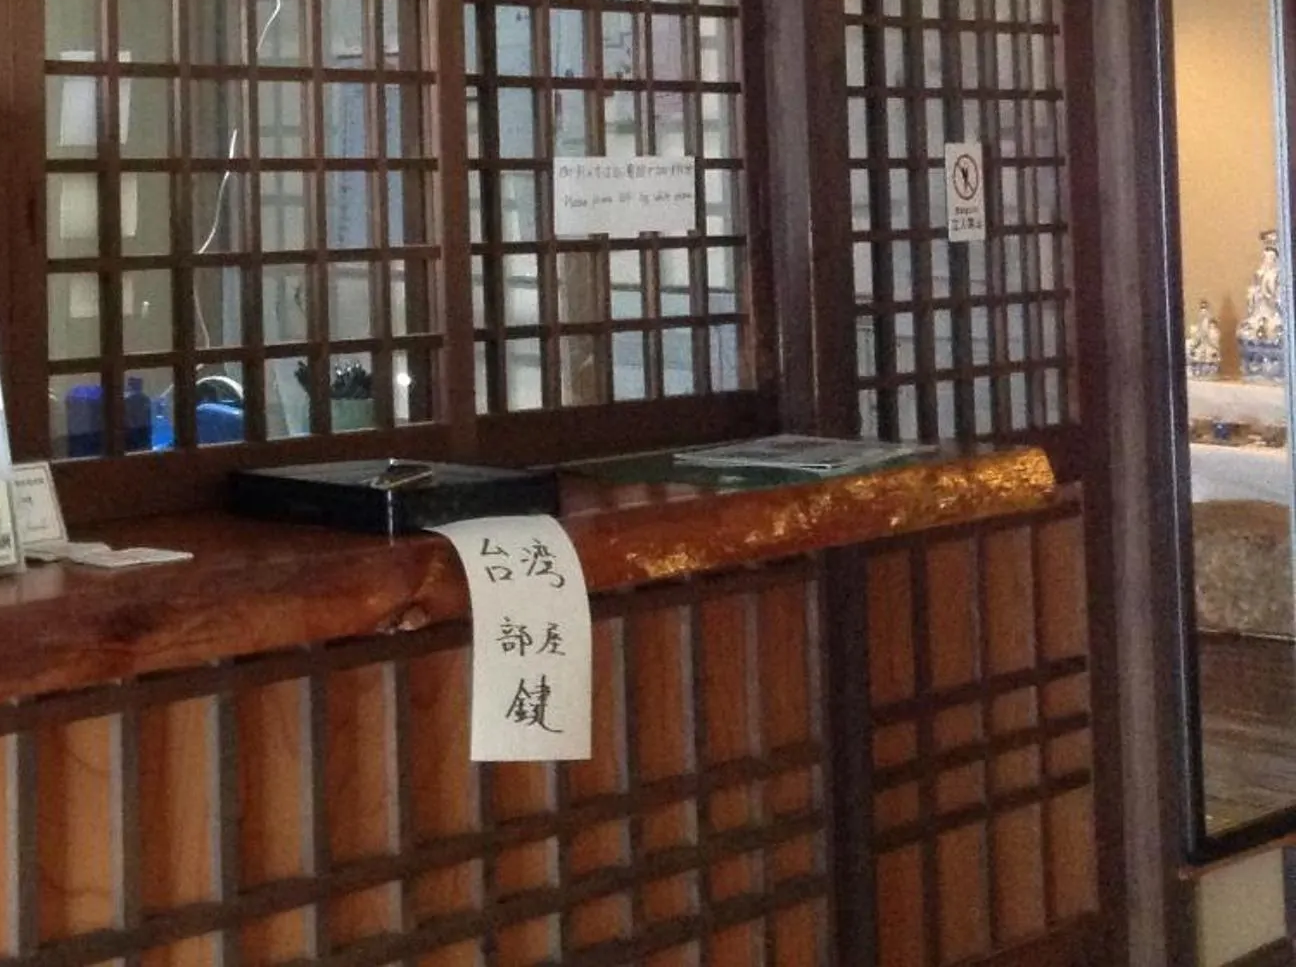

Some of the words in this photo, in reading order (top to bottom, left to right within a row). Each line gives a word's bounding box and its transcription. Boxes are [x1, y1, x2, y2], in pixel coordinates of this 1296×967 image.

[481, 538, 565, 588] 台湾
[496, 616, 566, 657] 部屋
[506, 674, 564, 733] 鍵
